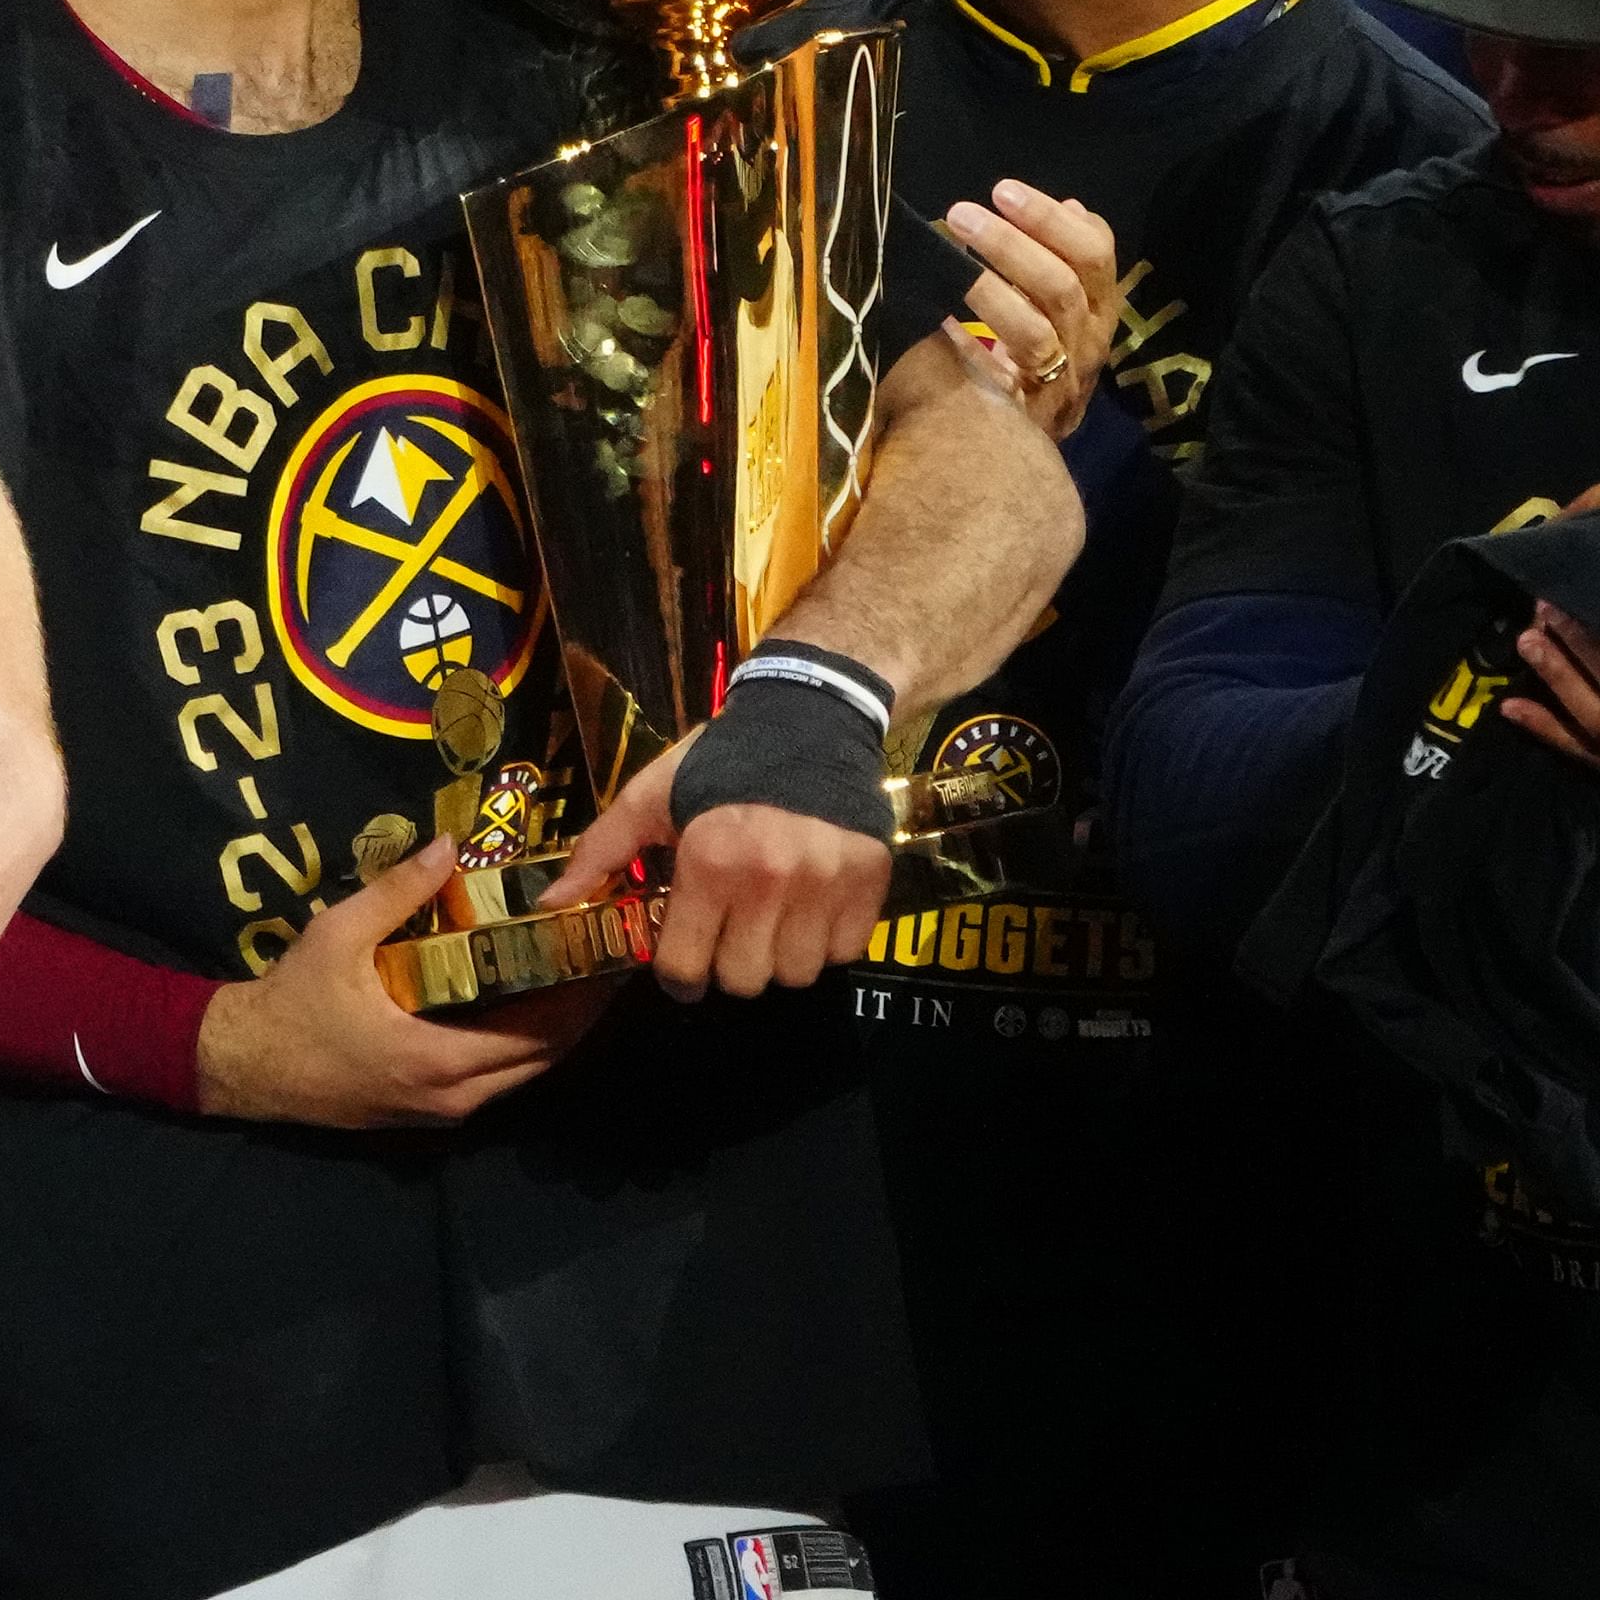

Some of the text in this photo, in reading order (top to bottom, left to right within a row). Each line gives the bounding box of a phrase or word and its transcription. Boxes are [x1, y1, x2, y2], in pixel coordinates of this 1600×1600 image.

[140, 300, 336, 553] NBA
[355, 246, 455, 352] C
[854, 987, 955, 1028] IT IN
